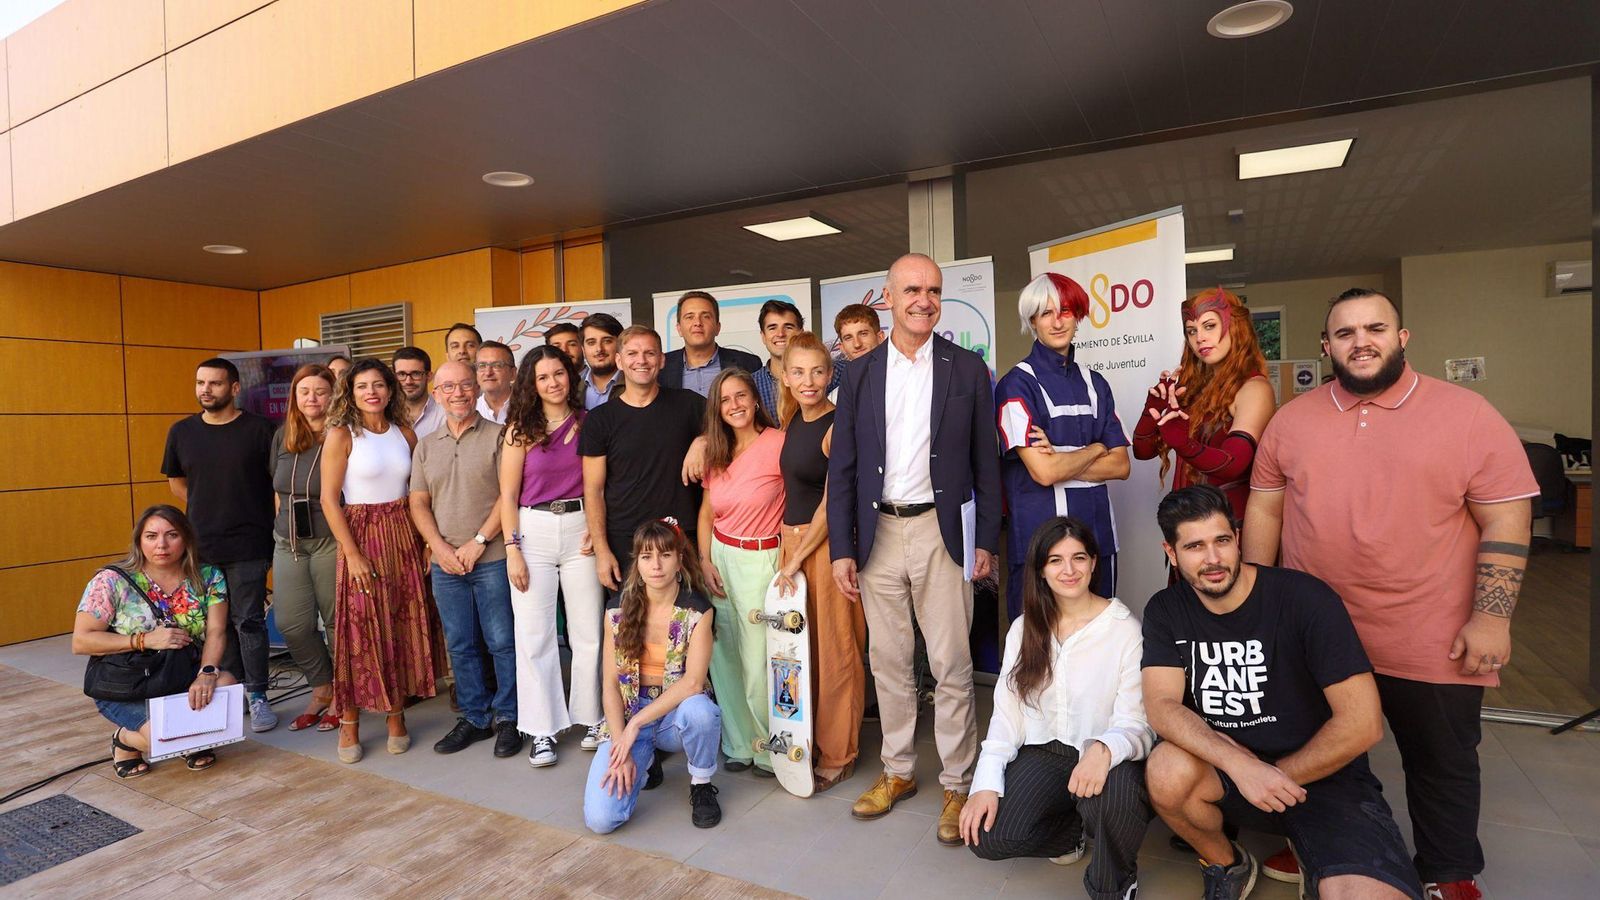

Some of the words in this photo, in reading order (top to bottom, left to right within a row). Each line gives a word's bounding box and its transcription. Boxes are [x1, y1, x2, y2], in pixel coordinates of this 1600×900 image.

[1072, 338, 1109, 350] TAMIENTO
[1110, 336, 1120, 347] DE
[1123, 333, 1154, 345] SEVILLA
[1093, 361, 1104, 371] de
[1106, 357, 1146, 370] Juventud
[1199, 639, 1265, 666] URB
[1200, 665, 1268, 692] ANF
[1202, 690, 1265, 717] EST
[1240, 715, 1277, 728] Inquieta
